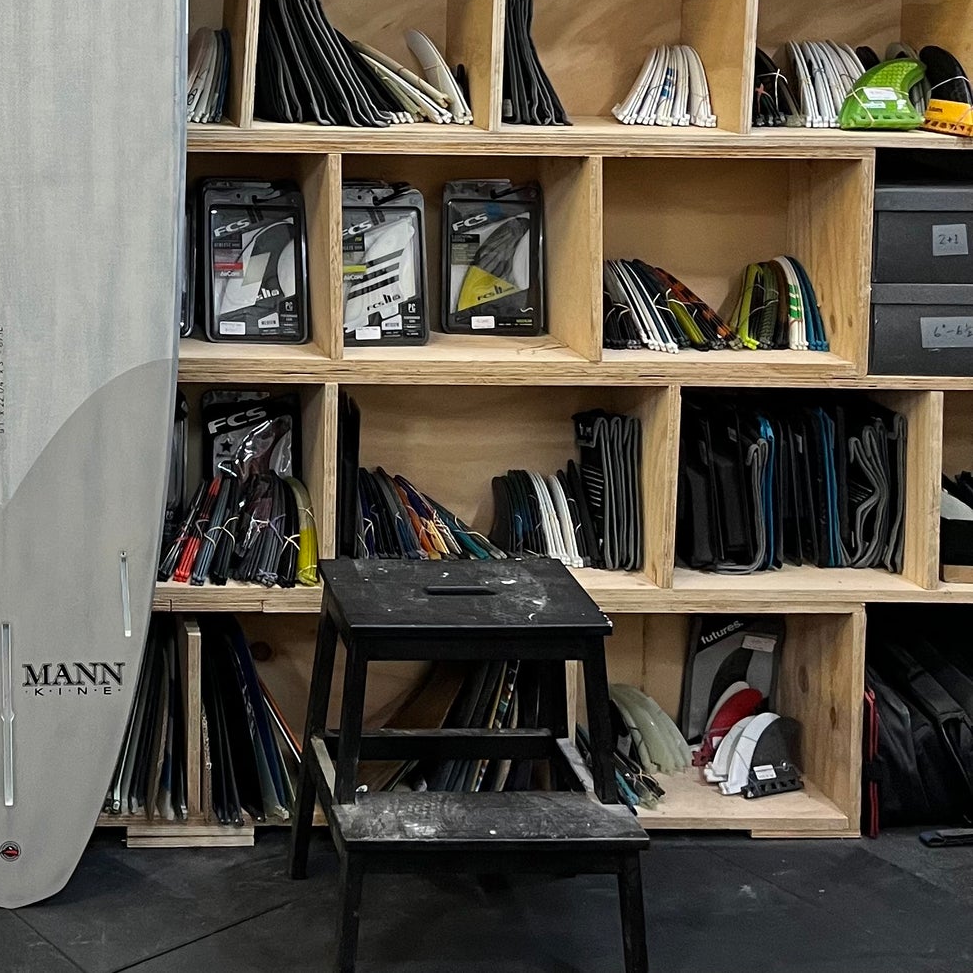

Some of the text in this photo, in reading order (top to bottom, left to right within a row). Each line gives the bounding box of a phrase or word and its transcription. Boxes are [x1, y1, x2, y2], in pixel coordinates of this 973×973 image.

[214, 217, 250, 237] FCS
[452, 213, 488, 232] FCS
[938, 234, 959, 245] 2+1
[207, 406, 267, 434] FCS
[701, 620, 744, 644] futures.
[22, 662, 126, 687] MANN
